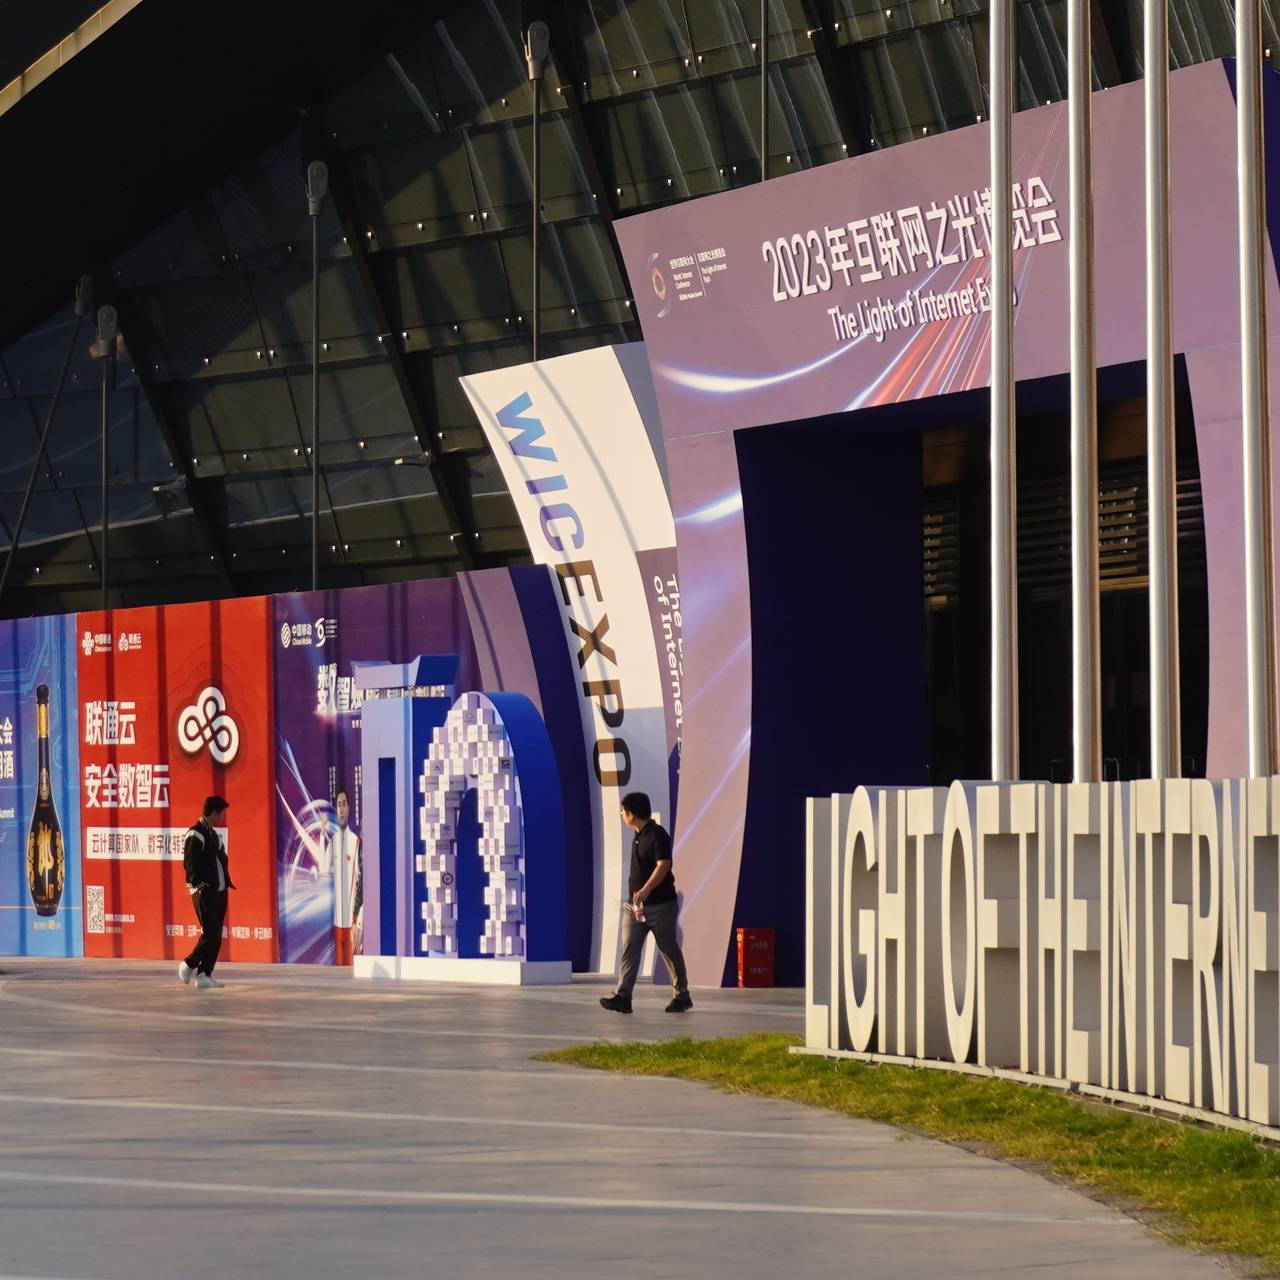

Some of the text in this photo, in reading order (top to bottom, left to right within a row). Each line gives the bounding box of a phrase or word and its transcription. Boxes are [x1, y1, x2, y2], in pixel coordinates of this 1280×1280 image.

[827, 306, 859, 341] The
[857, 297, 899, 343] Light
[898, 289, 916, 327] of
[913, 284, 978, 325] Internet
[667, 574, 682, 627] The
[654, 575, 682, 728] of Internet
[85, 700, 136, 745] 联通云
[85, 763, 169, 808] 安全数智云
[806, 785, 934, 1058] LIGHT
[941, 779, 999, 1067] OF
[1010, 782, 1090, 1084] THE
